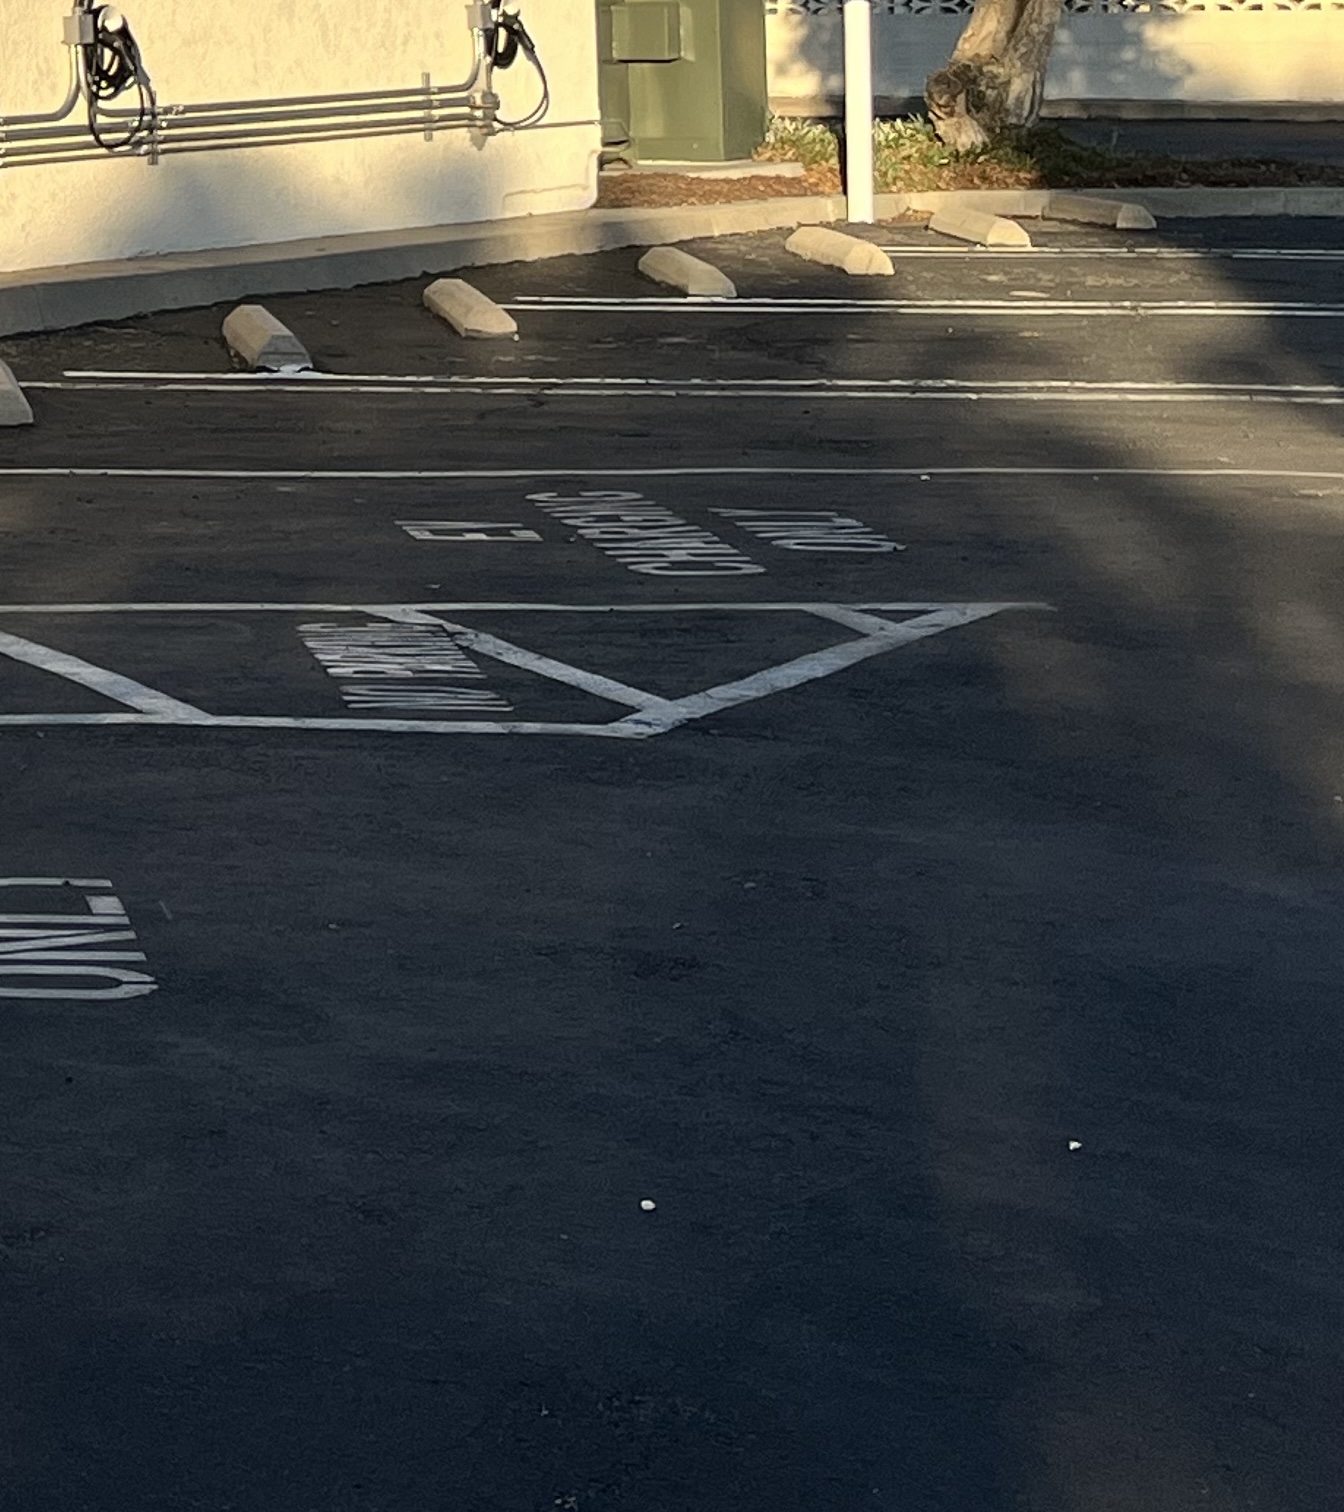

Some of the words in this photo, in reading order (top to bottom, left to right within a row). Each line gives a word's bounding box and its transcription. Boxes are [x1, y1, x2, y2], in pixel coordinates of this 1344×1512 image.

[394, 519, 544, 542] EV
[524, 490, 768, 576] CHARGING
[707, 506, 907, 552] ONLY
[297, 622, 488, 679] PARKING
[339, 685, 514, 712] NO
